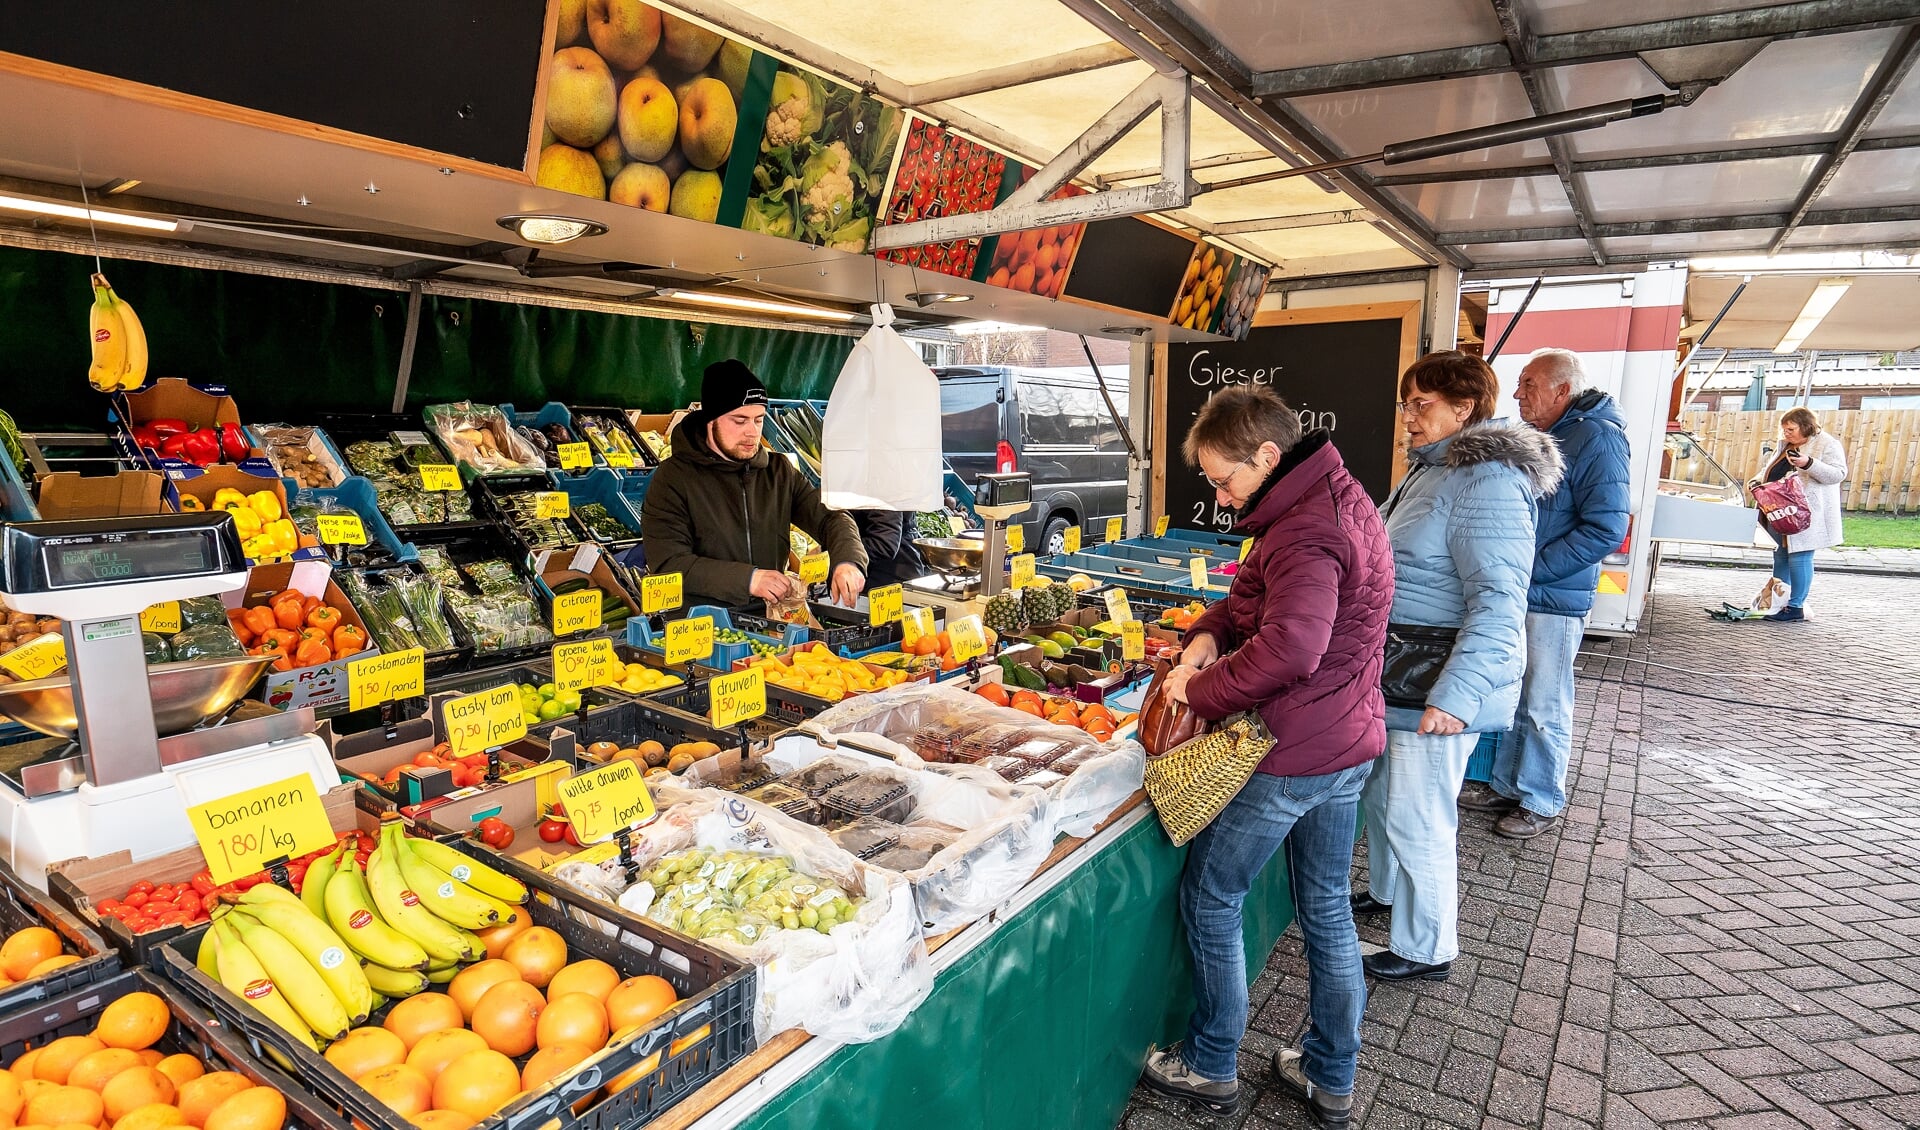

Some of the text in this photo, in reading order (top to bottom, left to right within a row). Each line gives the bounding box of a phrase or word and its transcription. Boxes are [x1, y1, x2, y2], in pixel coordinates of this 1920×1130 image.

[1188, 349, 1284, 386] Gieser
[1191, 499, 1233, 534] 2 kg
[44, 538, 63, 546] TEC
[645, 575, 678, 589] spruiten
[561, 594, 596, 608] citroen
[150, 616, 178, 629] /pond
[557, 618, 563, 628] 3
[566, 616, 585, 626] voor
[672, 620, 711, 640] gele kiwis
[954, 624, 970, 634] kaki
[12, 646, 40, 660] uien
[558, 640, 608, 662] groene kiwi
[678, 648, 691, 656] voor
[20, 654, 68, 678] 125 /k
[356, 653, 421, 677] trostomaten
[358, 678, 418, 708] 150 /pond
[558, 682, 565, 691] 10
[568, 678, 584, 688] voor
[717, 673, 757, 696] druiven
[450, 688, 514, 723] tasty tom
[453, 716, 522, 752] 250 /pond
[563, 764, 634, 800] witte druiven
[204, 786, 305, 830] bananen
[572, 796, 646, 838] 275 /pond
